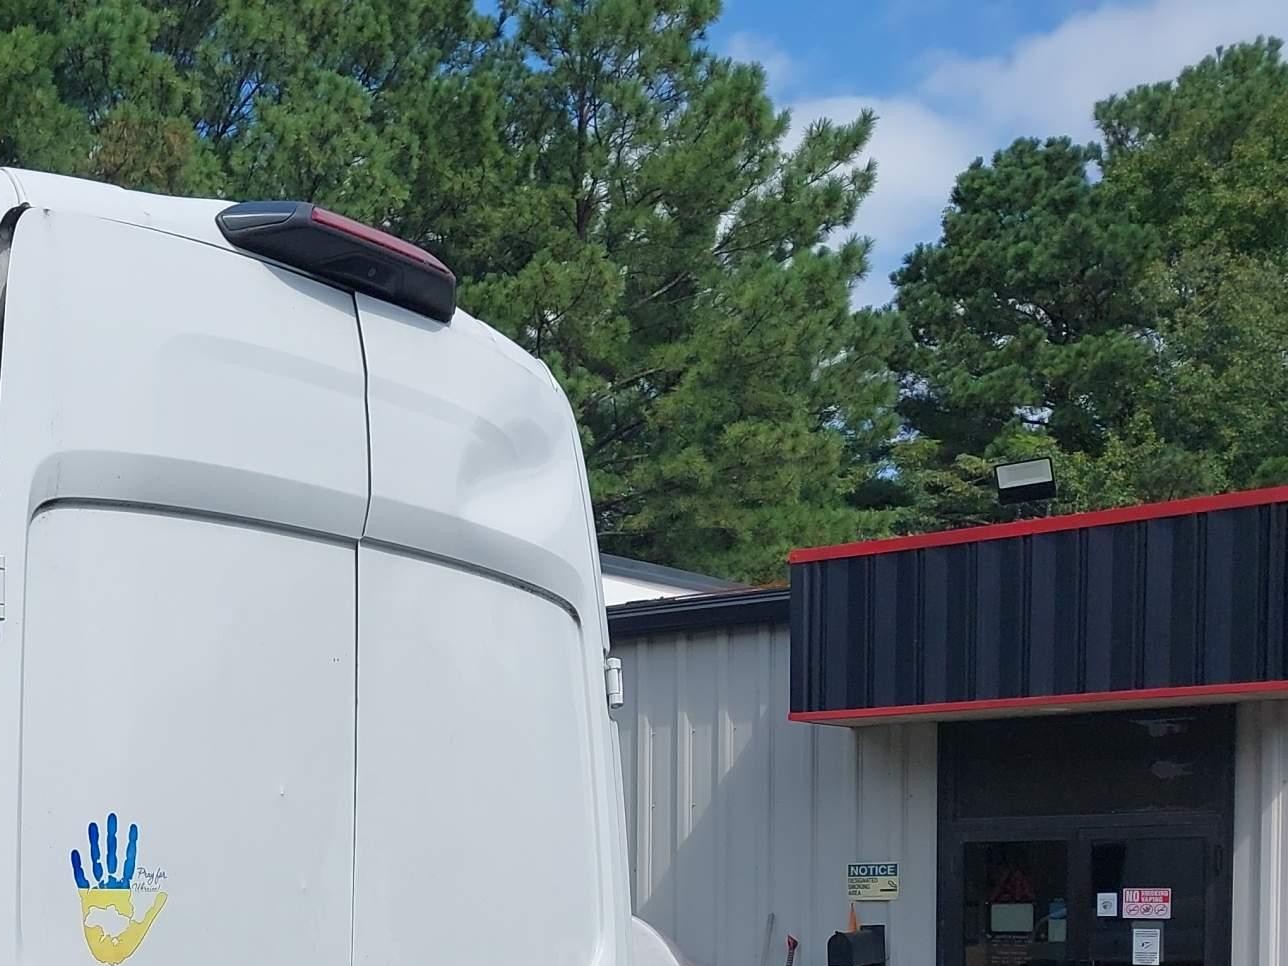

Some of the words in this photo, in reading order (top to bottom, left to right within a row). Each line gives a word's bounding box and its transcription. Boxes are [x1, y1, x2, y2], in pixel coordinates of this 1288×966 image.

[137, 866, 155, 885] Pray
[154, 867, 168, 885] for
[850, 865, 896, 876] NOTICE
[1126, 890, 1140, 902] NO
